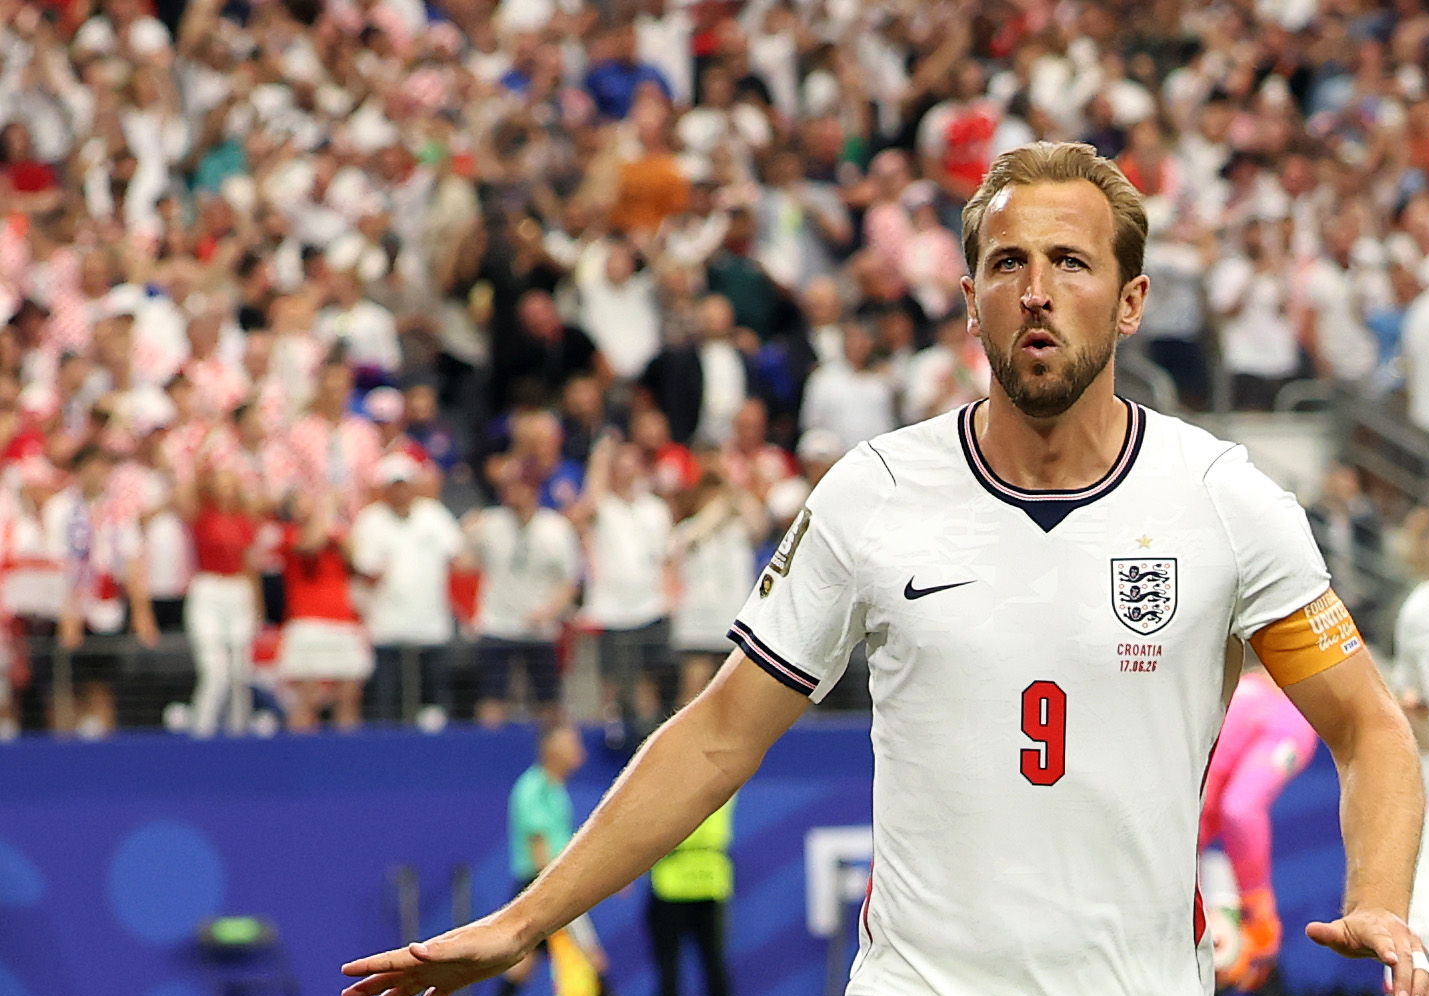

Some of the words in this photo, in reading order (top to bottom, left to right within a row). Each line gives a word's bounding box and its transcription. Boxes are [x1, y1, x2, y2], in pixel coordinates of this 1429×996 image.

[1117, 643, 1162, 656] CROATIA
[1120, 660, 1158, 672] 17.06.26
[1020, 680, 1067, 786] 9
